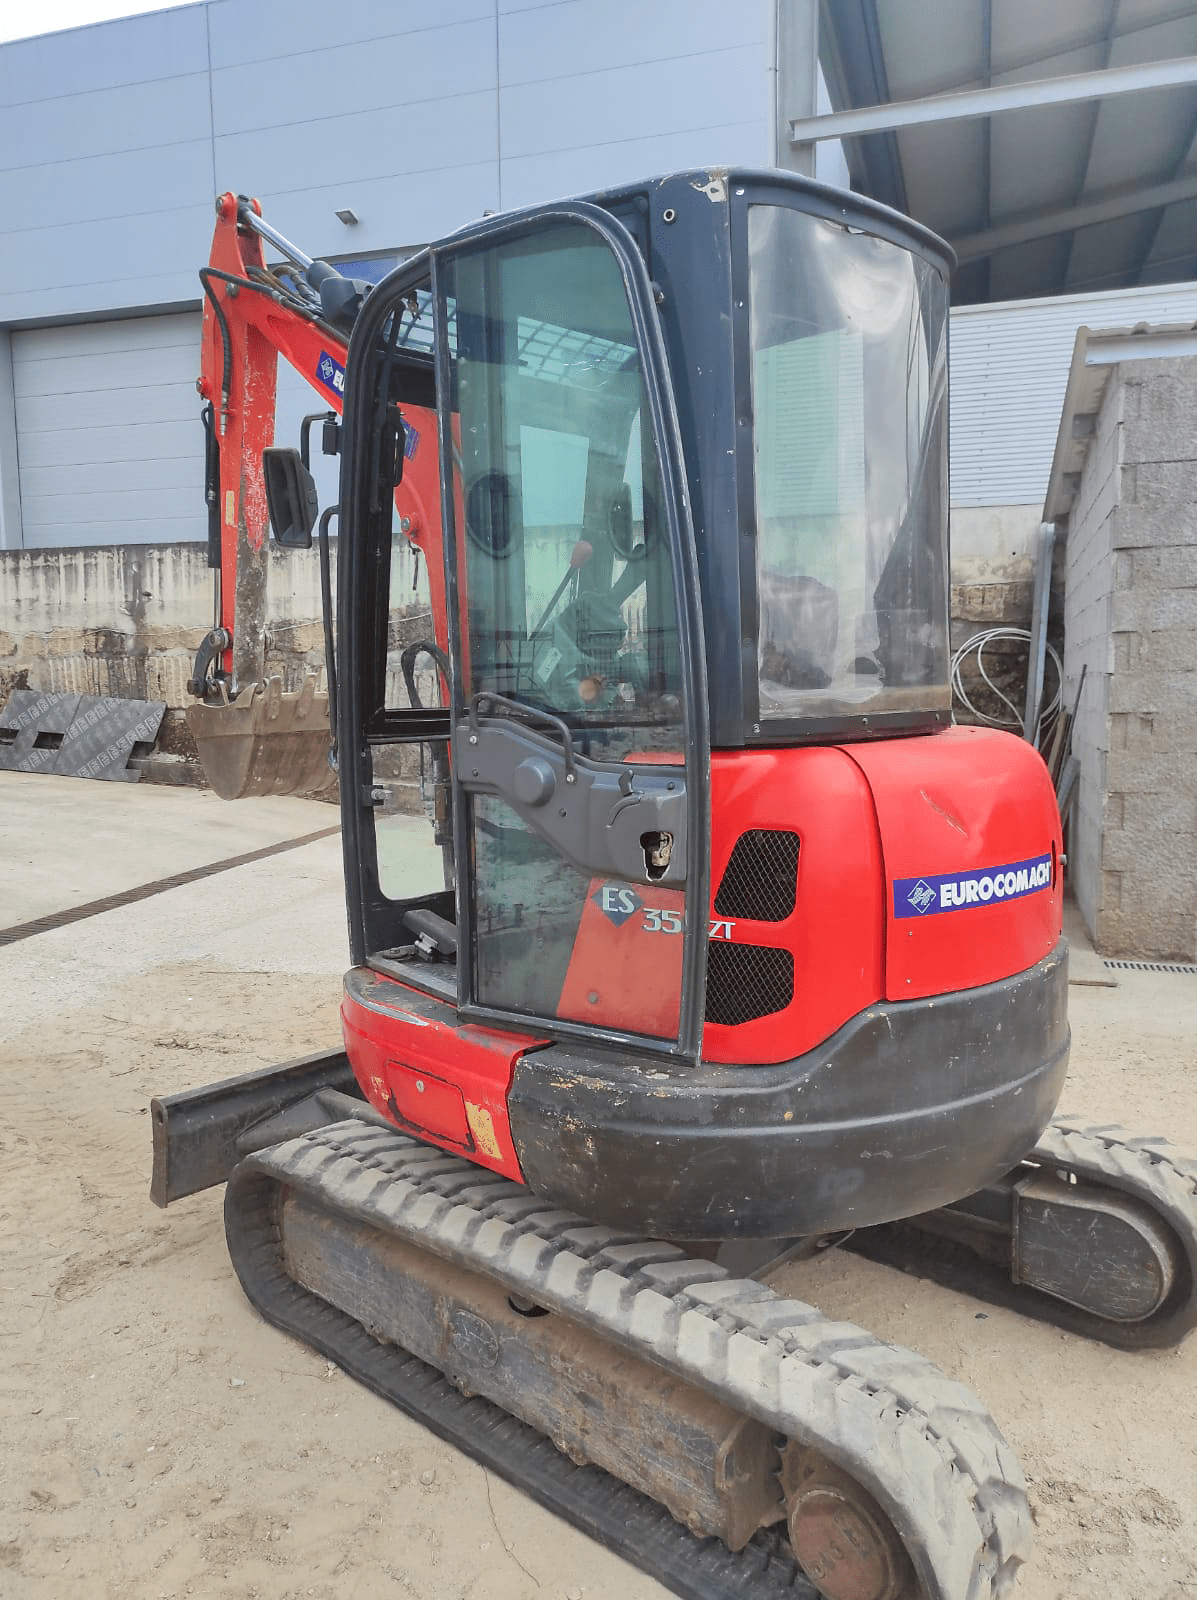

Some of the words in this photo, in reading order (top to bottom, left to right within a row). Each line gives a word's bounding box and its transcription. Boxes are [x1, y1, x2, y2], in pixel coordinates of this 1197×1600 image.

[602, 887, 635, 914] ES
[940, 861, 1052, 908] EUROCOMACH
[643, 908, 682, 933] 35
[708, 920, 736, 940] ZT
